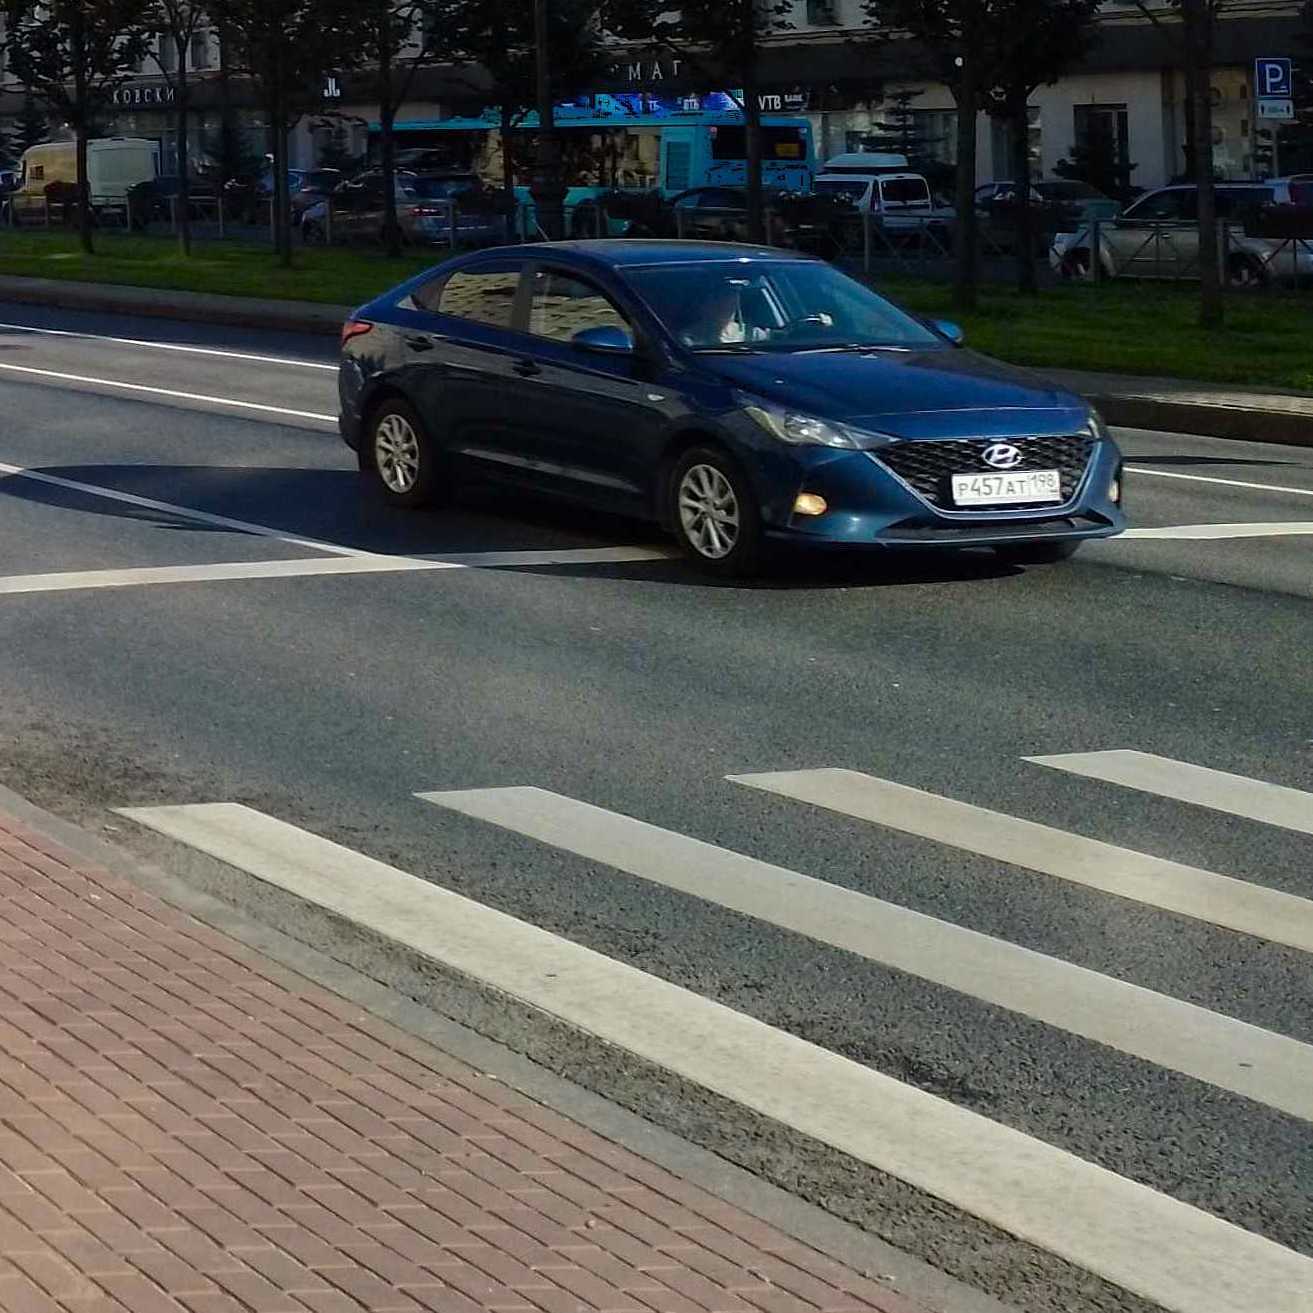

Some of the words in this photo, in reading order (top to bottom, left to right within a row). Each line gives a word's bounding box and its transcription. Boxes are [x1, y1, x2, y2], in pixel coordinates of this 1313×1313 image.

[1265, 63, 1283, 93] P
[113, 86, 174, 104] КОВСКИ
[757, 94, 782, 111] VTB
